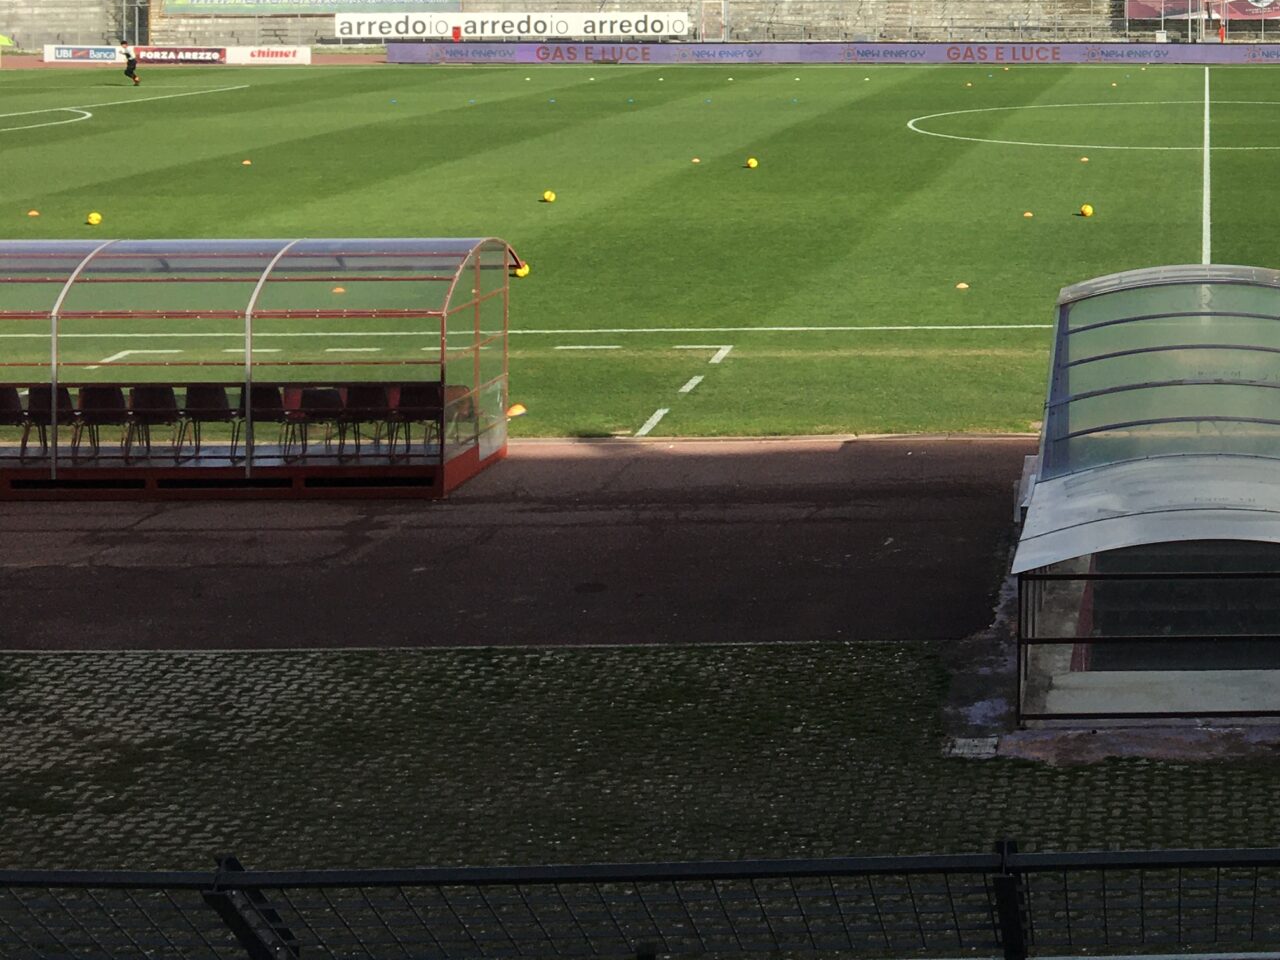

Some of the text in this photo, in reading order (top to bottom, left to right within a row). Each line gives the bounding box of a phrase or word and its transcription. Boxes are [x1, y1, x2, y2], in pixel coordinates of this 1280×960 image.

[56, 49, 116, 60] UBI Banca
[139, 50, 219, 61] FORZA AREZZO
[249, 48, 297, 59] chimet
[536, 46, 651, 61] GAS E LUCE
[946, 46, 1060, 61] GAS E LUCE
